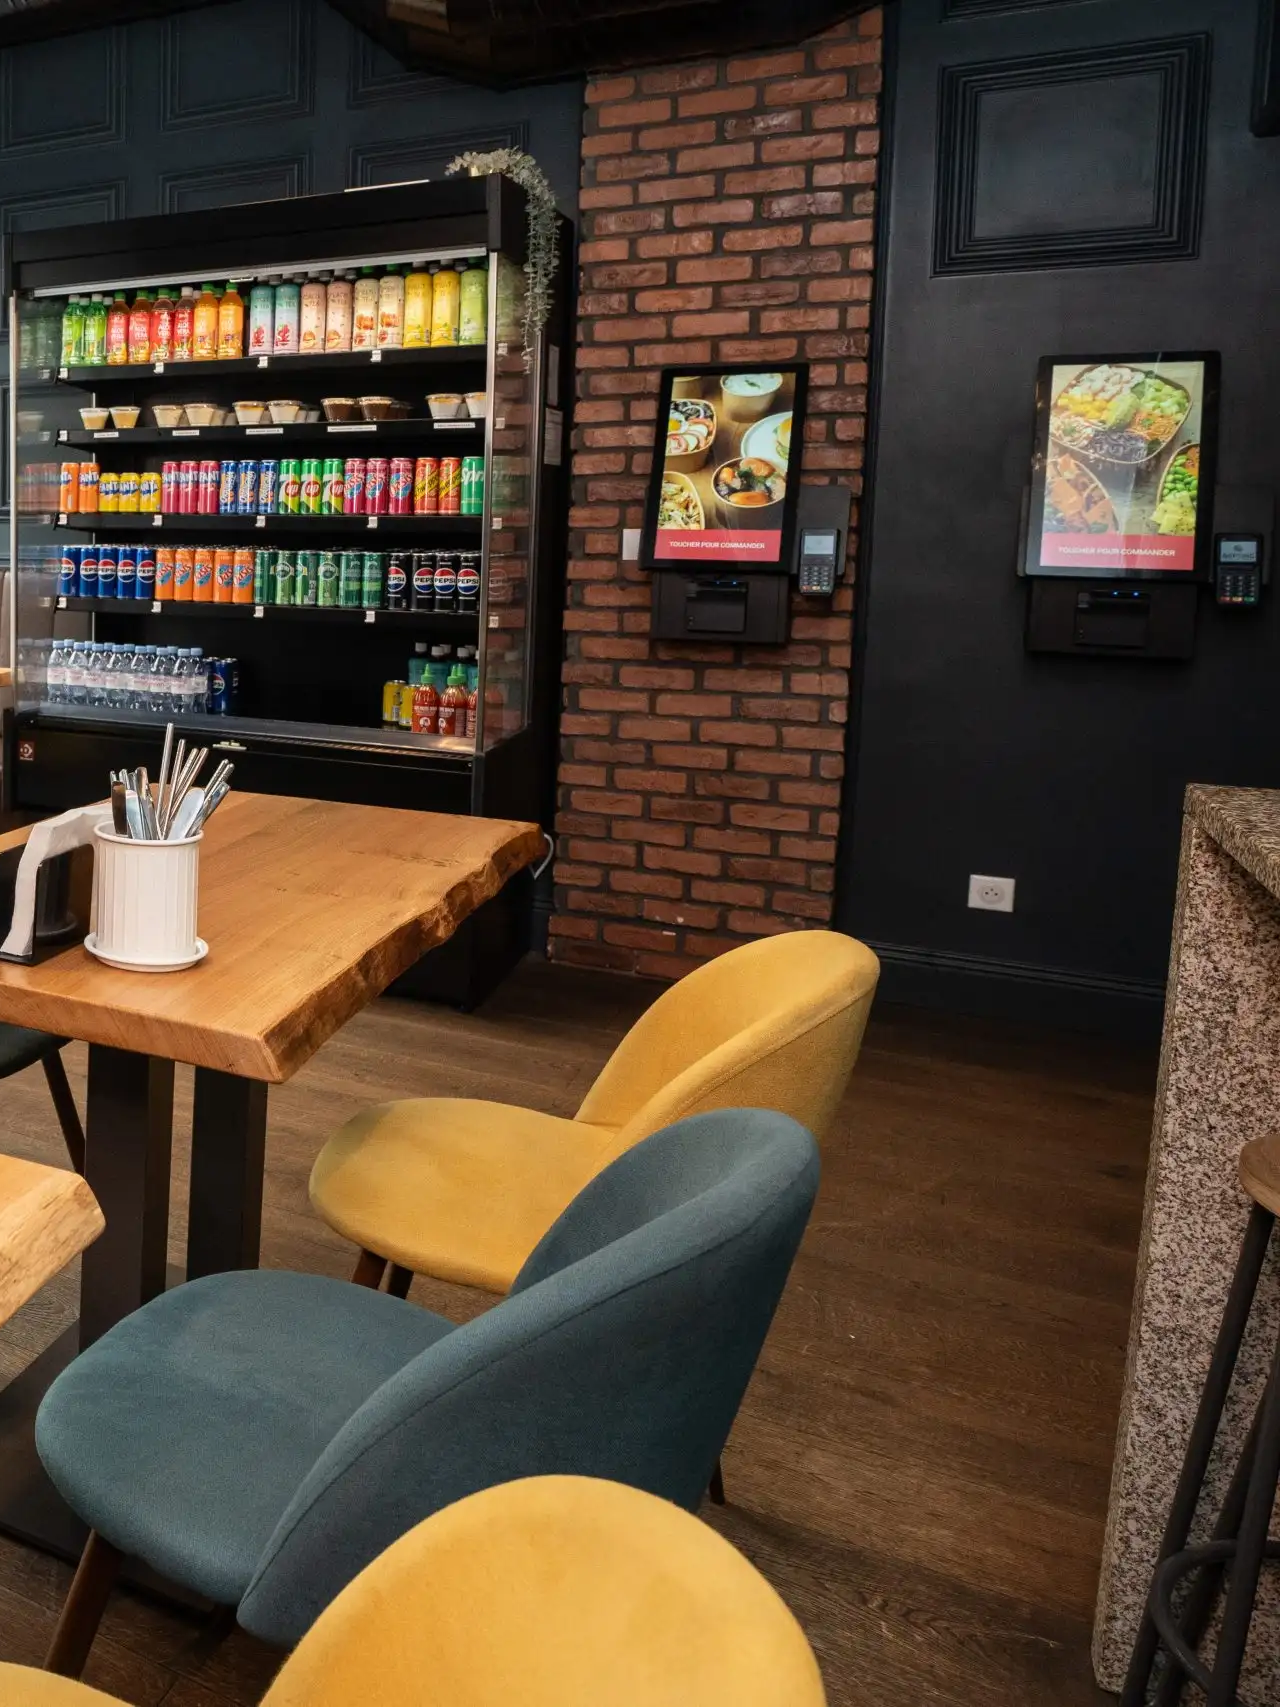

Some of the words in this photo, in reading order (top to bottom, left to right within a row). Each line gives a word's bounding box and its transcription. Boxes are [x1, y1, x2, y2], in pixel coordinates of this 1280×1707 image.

[1059, 546, 1095, 554] TOUCHER
[1097, 547, 1120, 555] POUR
[1121, 548, 1176, 556] COMMANDER
